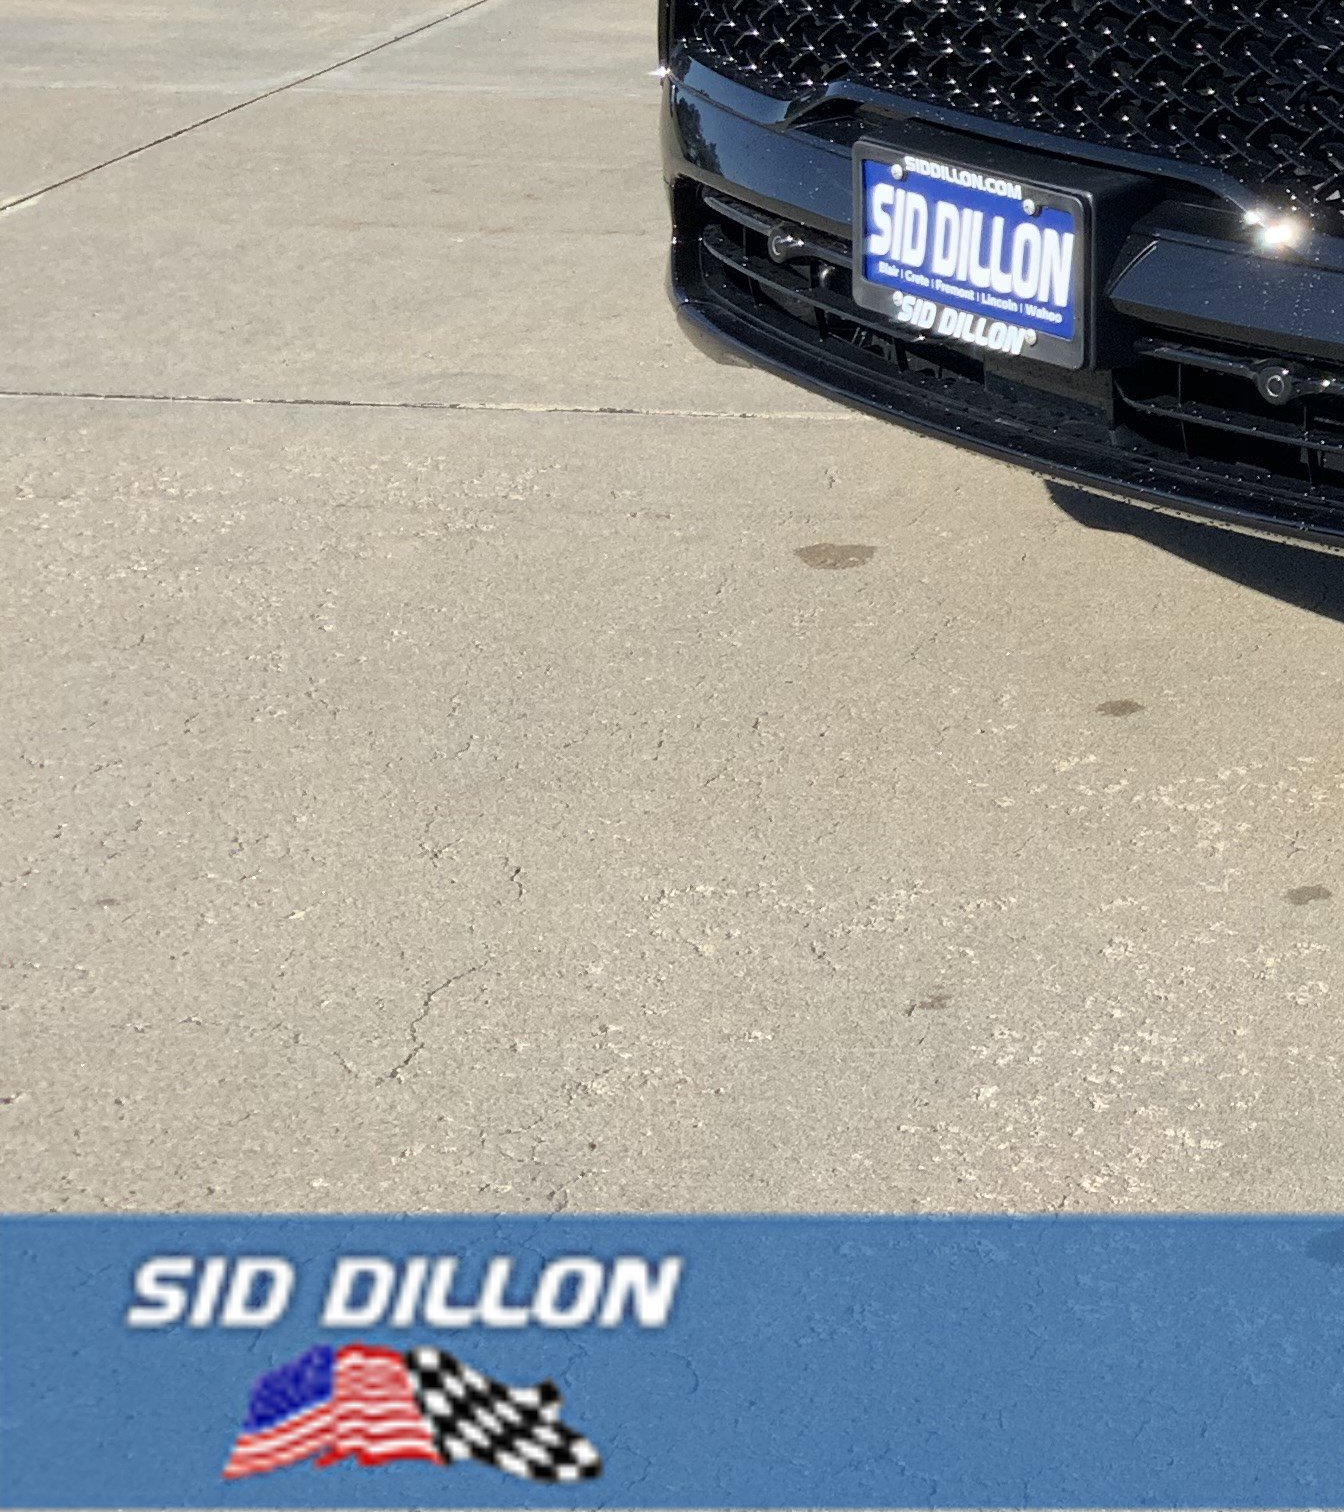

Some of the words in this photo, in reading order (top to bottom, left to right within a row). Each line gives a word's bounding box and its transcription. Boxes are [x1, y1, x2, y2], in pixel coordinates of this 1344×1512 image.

[904, 155, 1023, 201] SIDDILLON.COM
[868, 182, 929, 268] SID
[930, 199, 1076, 308] DILLON
[878, 261, 900, 279] Blair
[905, 269, 931, 288] Crete
[935, 279, 976, 302] Fremont
[981, 292, 1019, 314] Lincoln
[1025, 303, 1064, 325] Wahoo
[897, 296, 938, 330] SID
[938, 306, 1028, 356] DILLON
